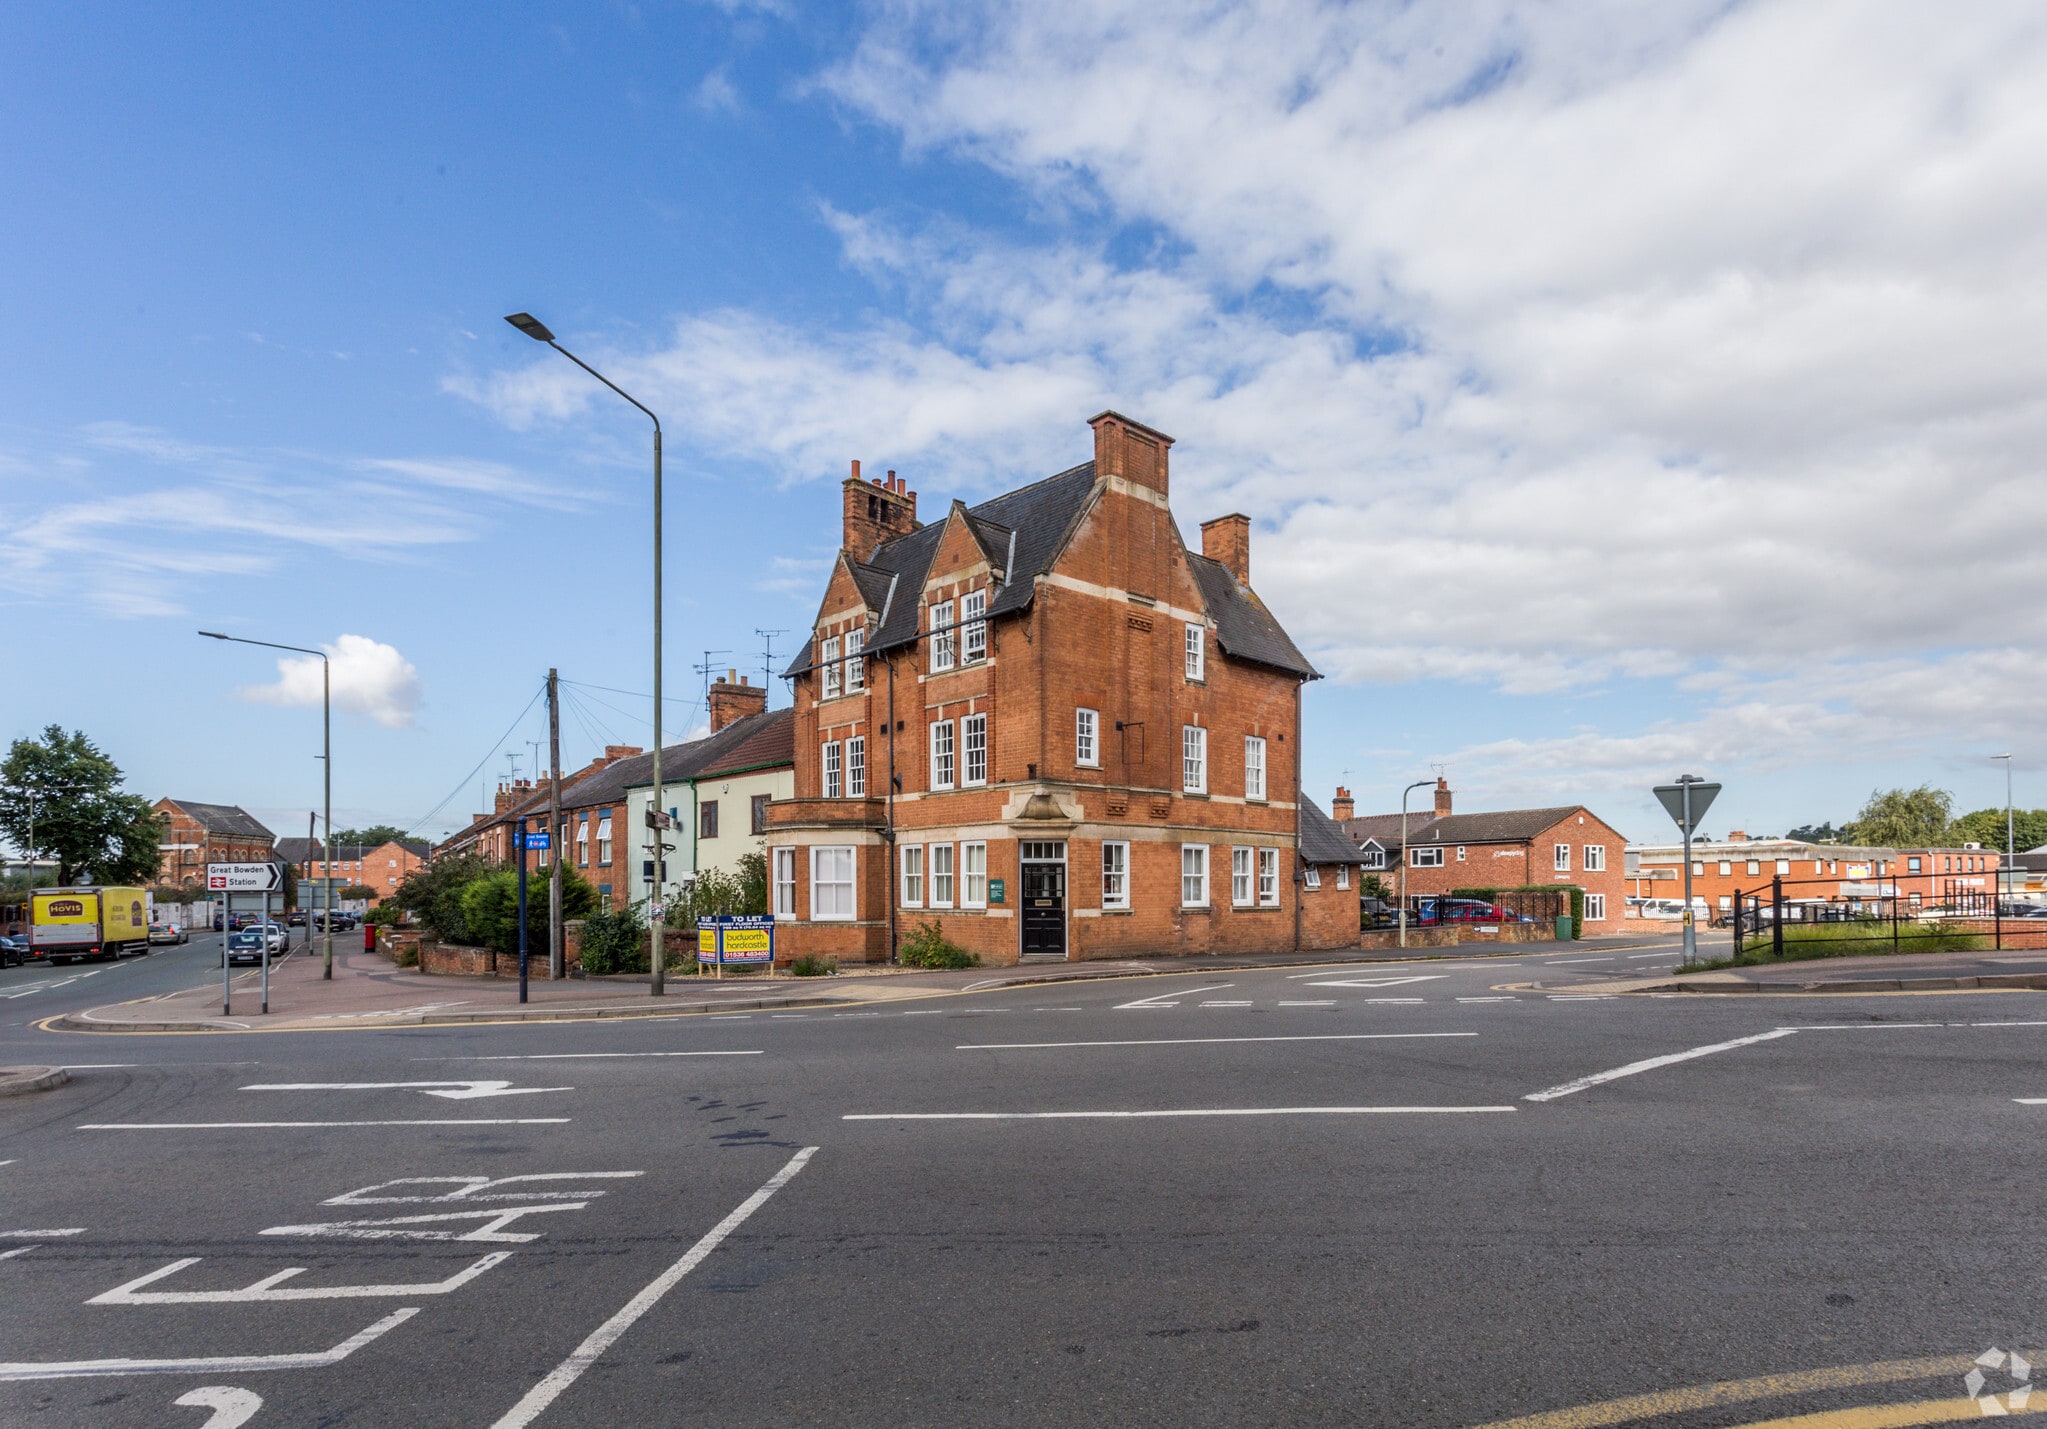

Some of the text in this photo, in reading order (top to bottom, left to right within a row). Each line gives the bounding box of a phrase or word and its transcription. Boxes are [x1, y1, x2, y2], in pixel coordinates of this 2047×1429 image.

[210, 866, 264, 874] Great Bowden
[229, 878, 257, 886] Station
[727, 931, 764, 941] budworth
[727, 941, 767, 949] hardcastle
